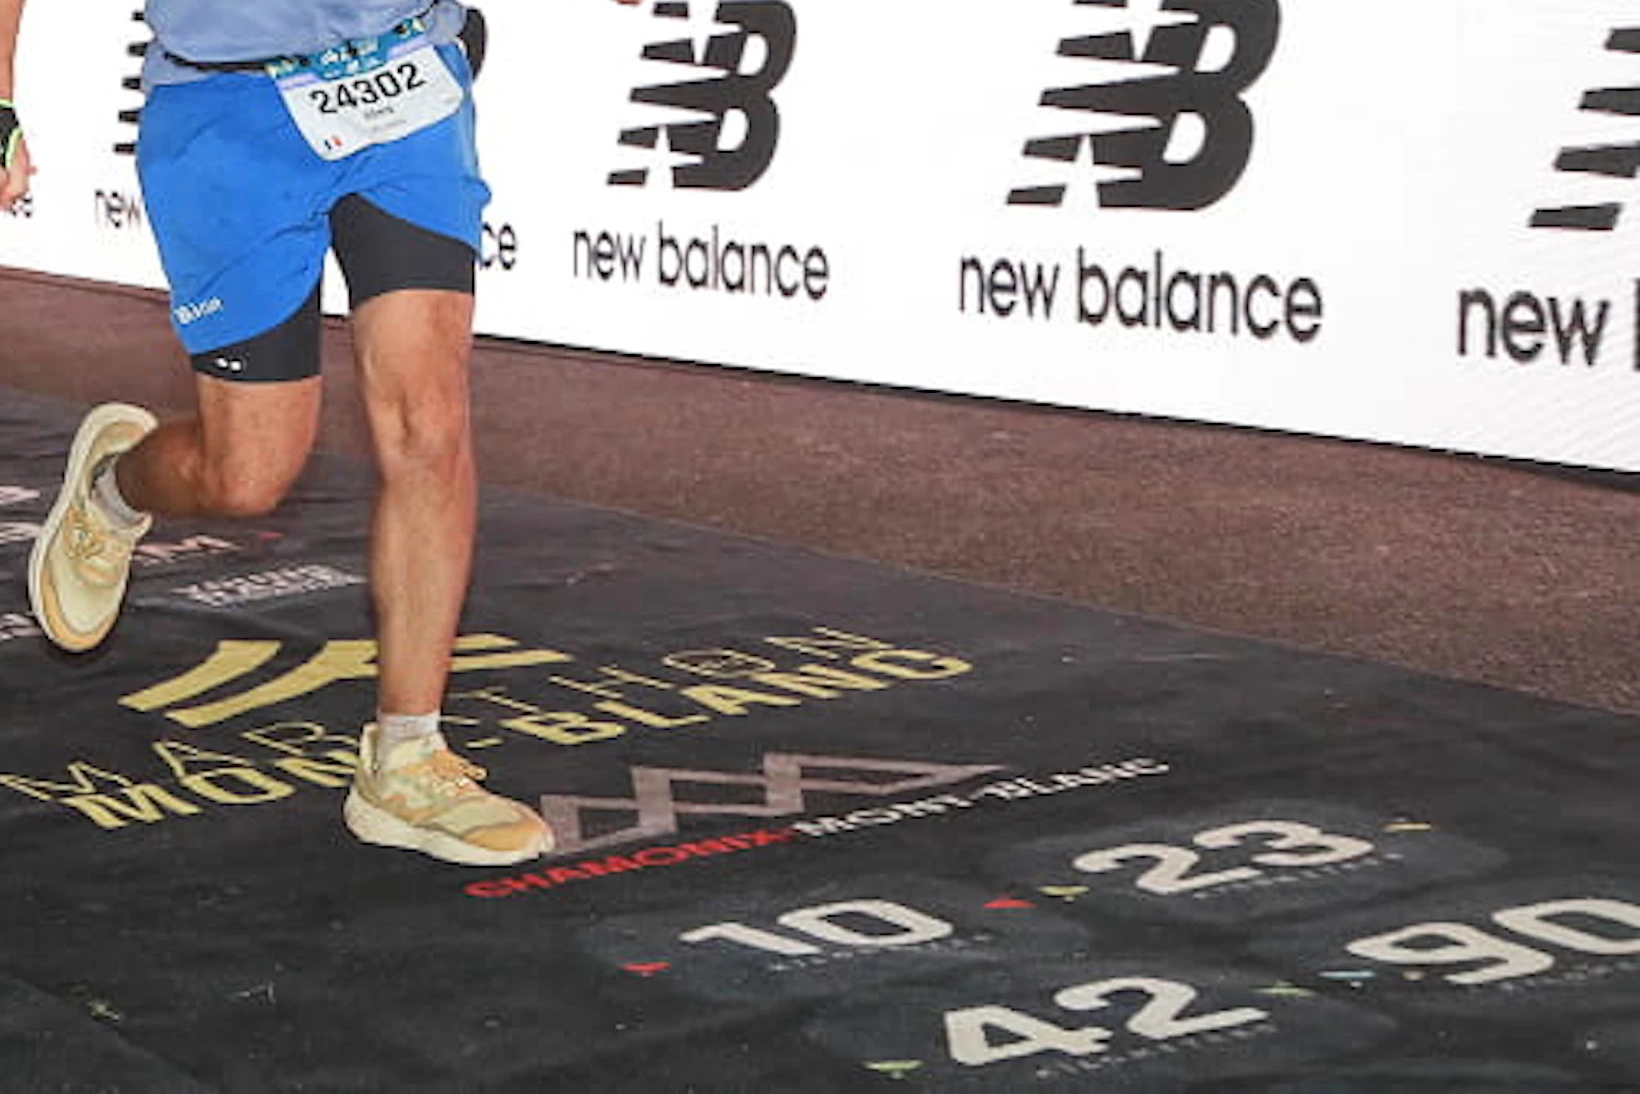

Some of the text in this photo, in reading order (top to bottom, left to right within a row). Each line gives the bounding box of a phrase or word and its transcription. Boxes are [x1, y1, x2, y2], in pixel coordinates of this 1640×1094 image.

[309, 62, 426, 115] 24302
[572, 226, 647, 283] new
[657, 221, 830, 301] balance
[959, 245, 1324, 344] new balance
[1456, 286, 1611, 367] new
[1072, 819, 1376, 895] 23
[678, 898, 954, 956] 10
[1345, 897, 1640, 985] 90
[943, 975, 1269, 1067] 42
